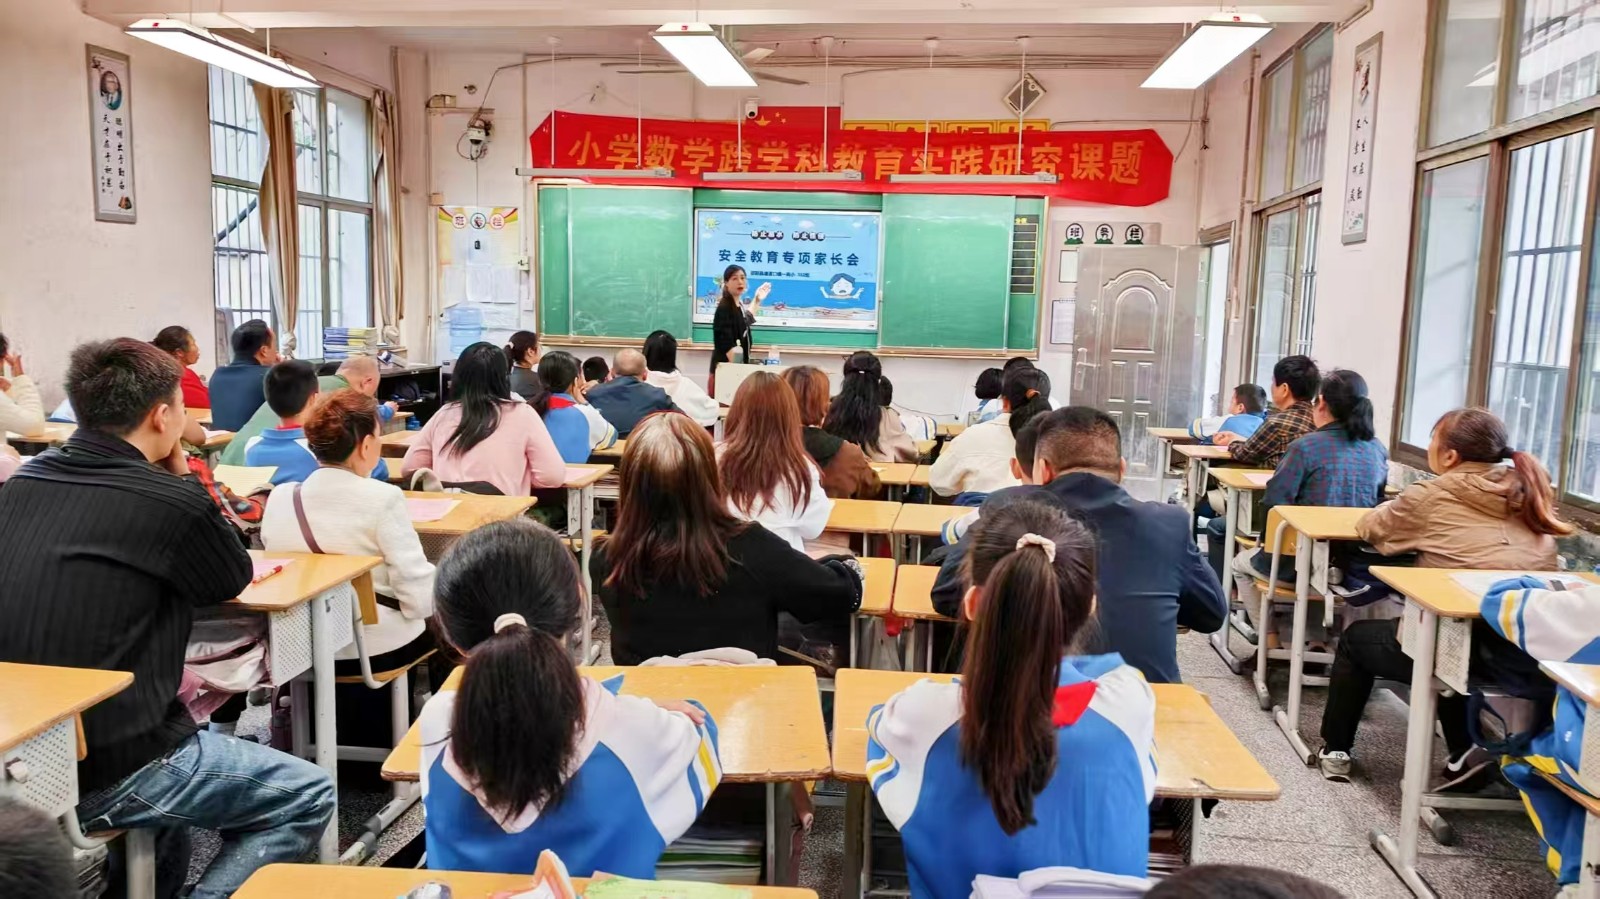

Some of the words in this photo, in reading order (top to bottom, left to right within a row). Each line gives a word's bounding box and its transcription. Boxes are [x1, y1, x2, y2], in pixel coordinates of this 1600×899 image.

[567, 130, 1144, 185] 小学数学跨学科教育实践研究课题
[718, 249, 860, 267] 安全教育专项家长会
